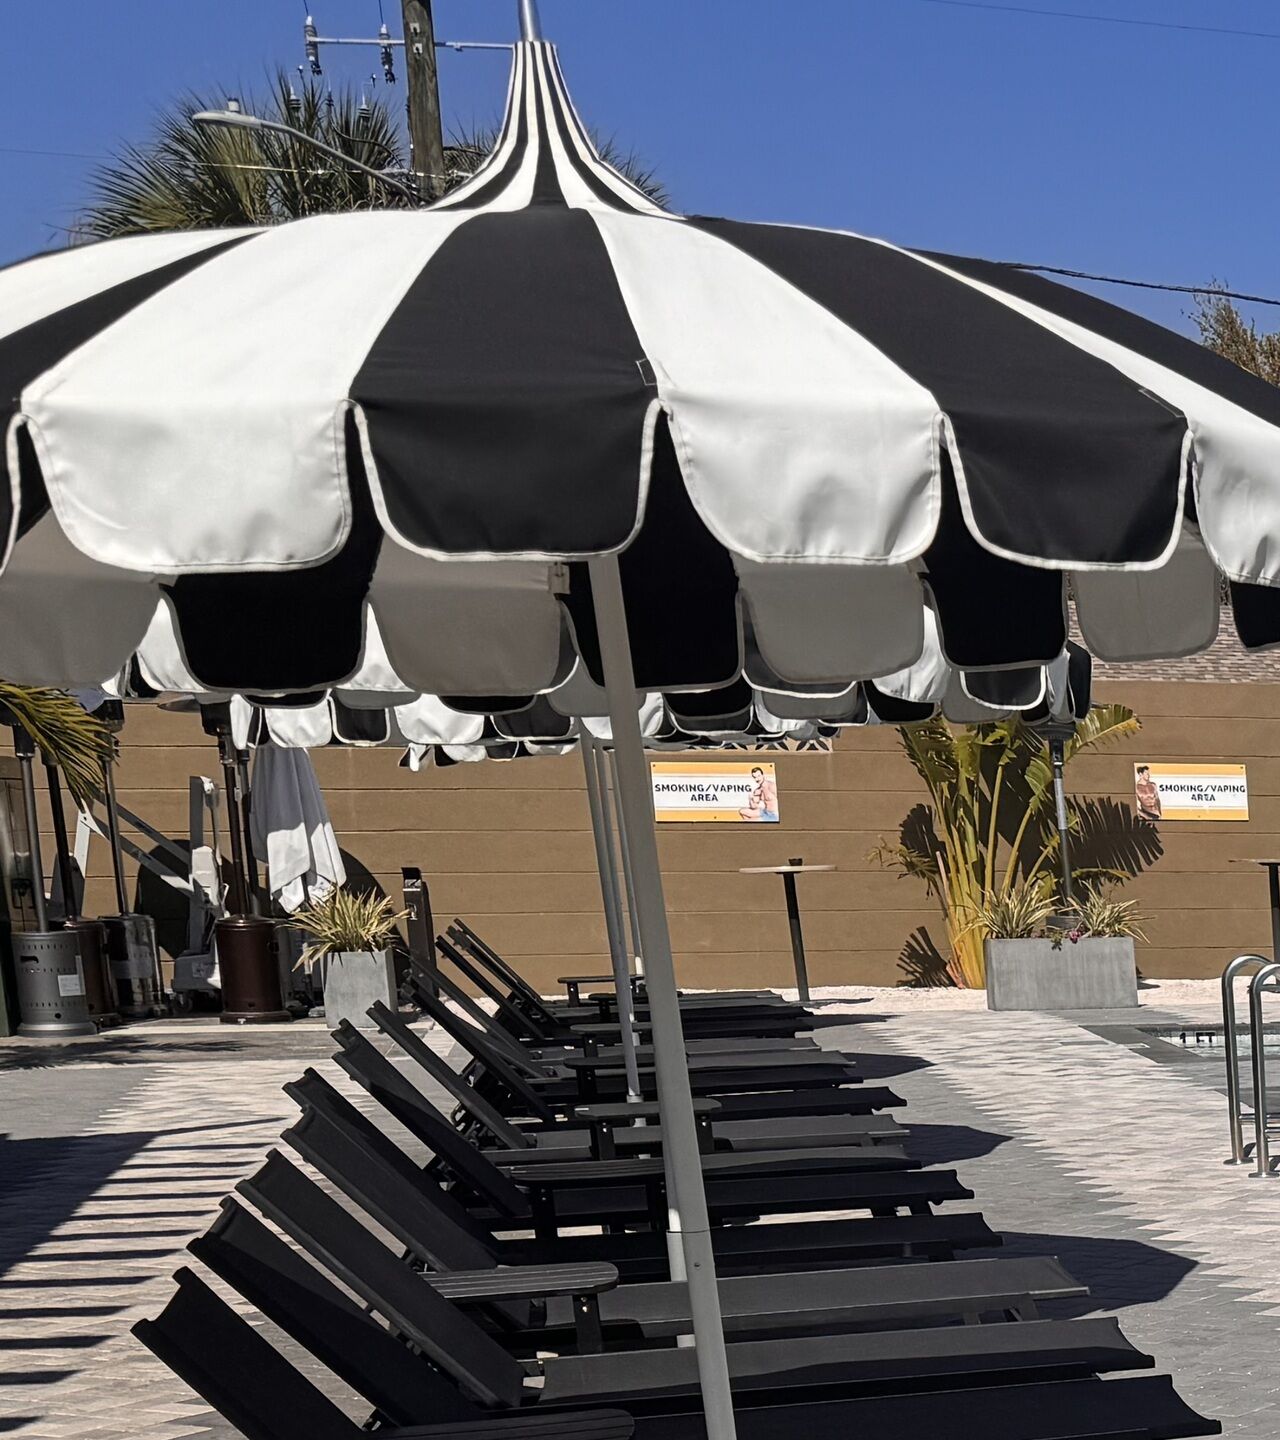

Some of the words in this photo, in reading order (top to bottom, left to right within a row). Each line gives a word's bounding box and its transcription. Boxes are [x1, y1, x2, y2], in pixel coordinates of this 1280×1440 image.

[654, 783, 752, 793] SMOKING/VAPING
[1159, 784, 1246, 793] SMOKING/VAPING
[690, 793, 719, 802] AREA
[1190, 793, 1216, 802] AREA
[1195, 1032, 1216, 1044] FT
